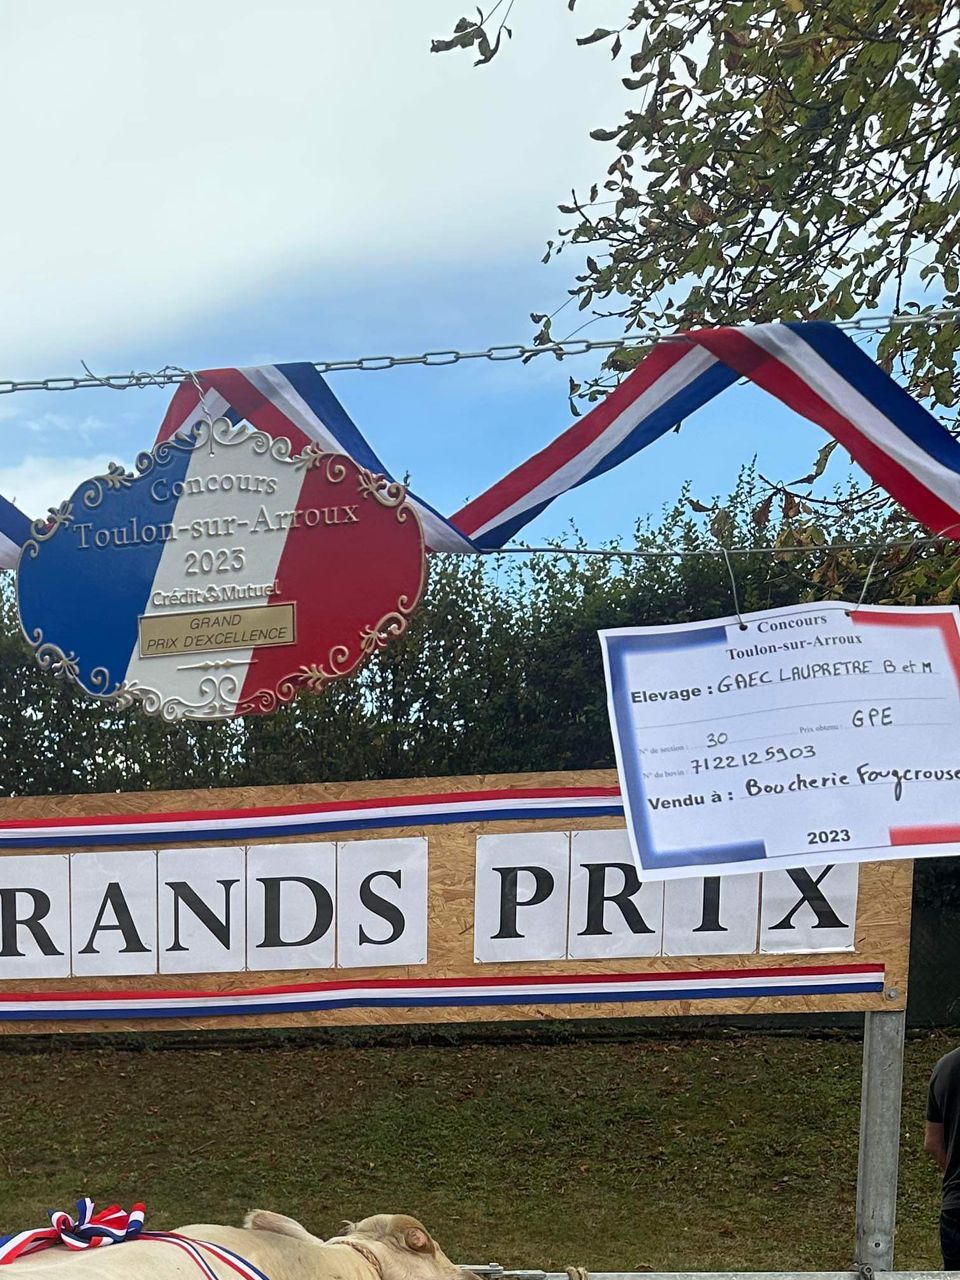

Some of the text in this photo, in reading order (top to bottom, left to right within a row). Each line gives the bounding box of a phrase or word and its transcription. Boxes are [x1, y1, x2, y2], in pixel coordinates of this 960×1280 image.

[150, 472, 278, 503] Concours
[74, 503, 360, 551] Toulon-sur-Arroux
[184, 547, 246, 577] 2023
[151, 579, 282, 606] Crédit Mutuel
[189, 615, 242, 630] GRAND
[757, 614, 828, 635] Concours
[147, 626, 288, 651] PRIX D'EXCELLENCE
[726, 632, 863, 661] Toulon-sur-Arroux
[631, 684, 702, 704] Elevage
[717, 669, 772, 693] GAEC
[779, 660, 873, 682] LAUPRETRE
[902, 659, 915, 673] et
[922, 661, 933, 674] M
[800, 726, 814, 734] Prix
[852, 706, 892, 728] GPE
[706, 732, 729, 748] 30
[648, 793, 705, 811] Vendu
[713, 789, 724, 804] à
[745, 772, 850, 797] Boucherie
[807, 829, 851, 845] 2023
[489, 862, 850, 939] PRIX
